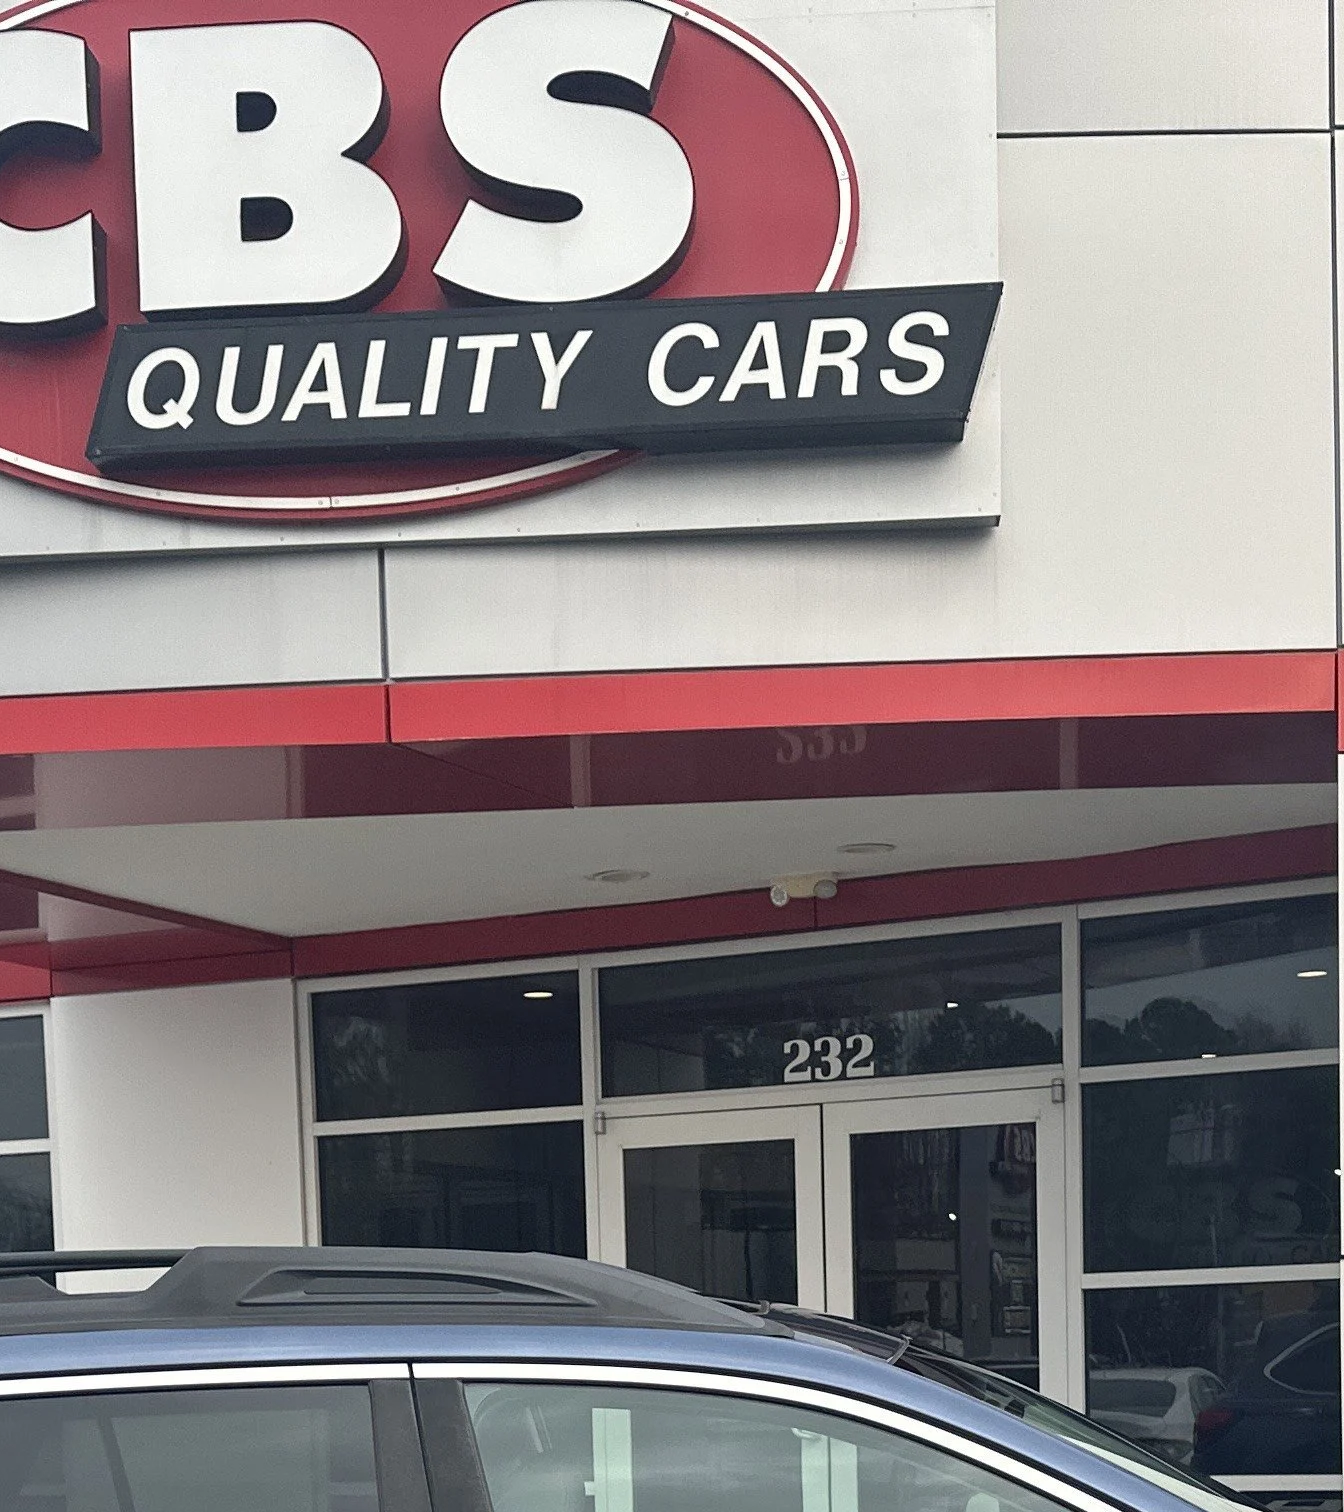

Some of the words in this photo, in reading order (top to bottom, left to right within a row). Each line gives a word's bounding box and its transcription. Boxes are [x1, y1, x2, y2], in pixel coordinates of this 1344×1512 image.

[126, 328, 595, 431] QUALITY
[646, 310, 951, 408] CARS
[782, 1033, 876, 1083] 232
